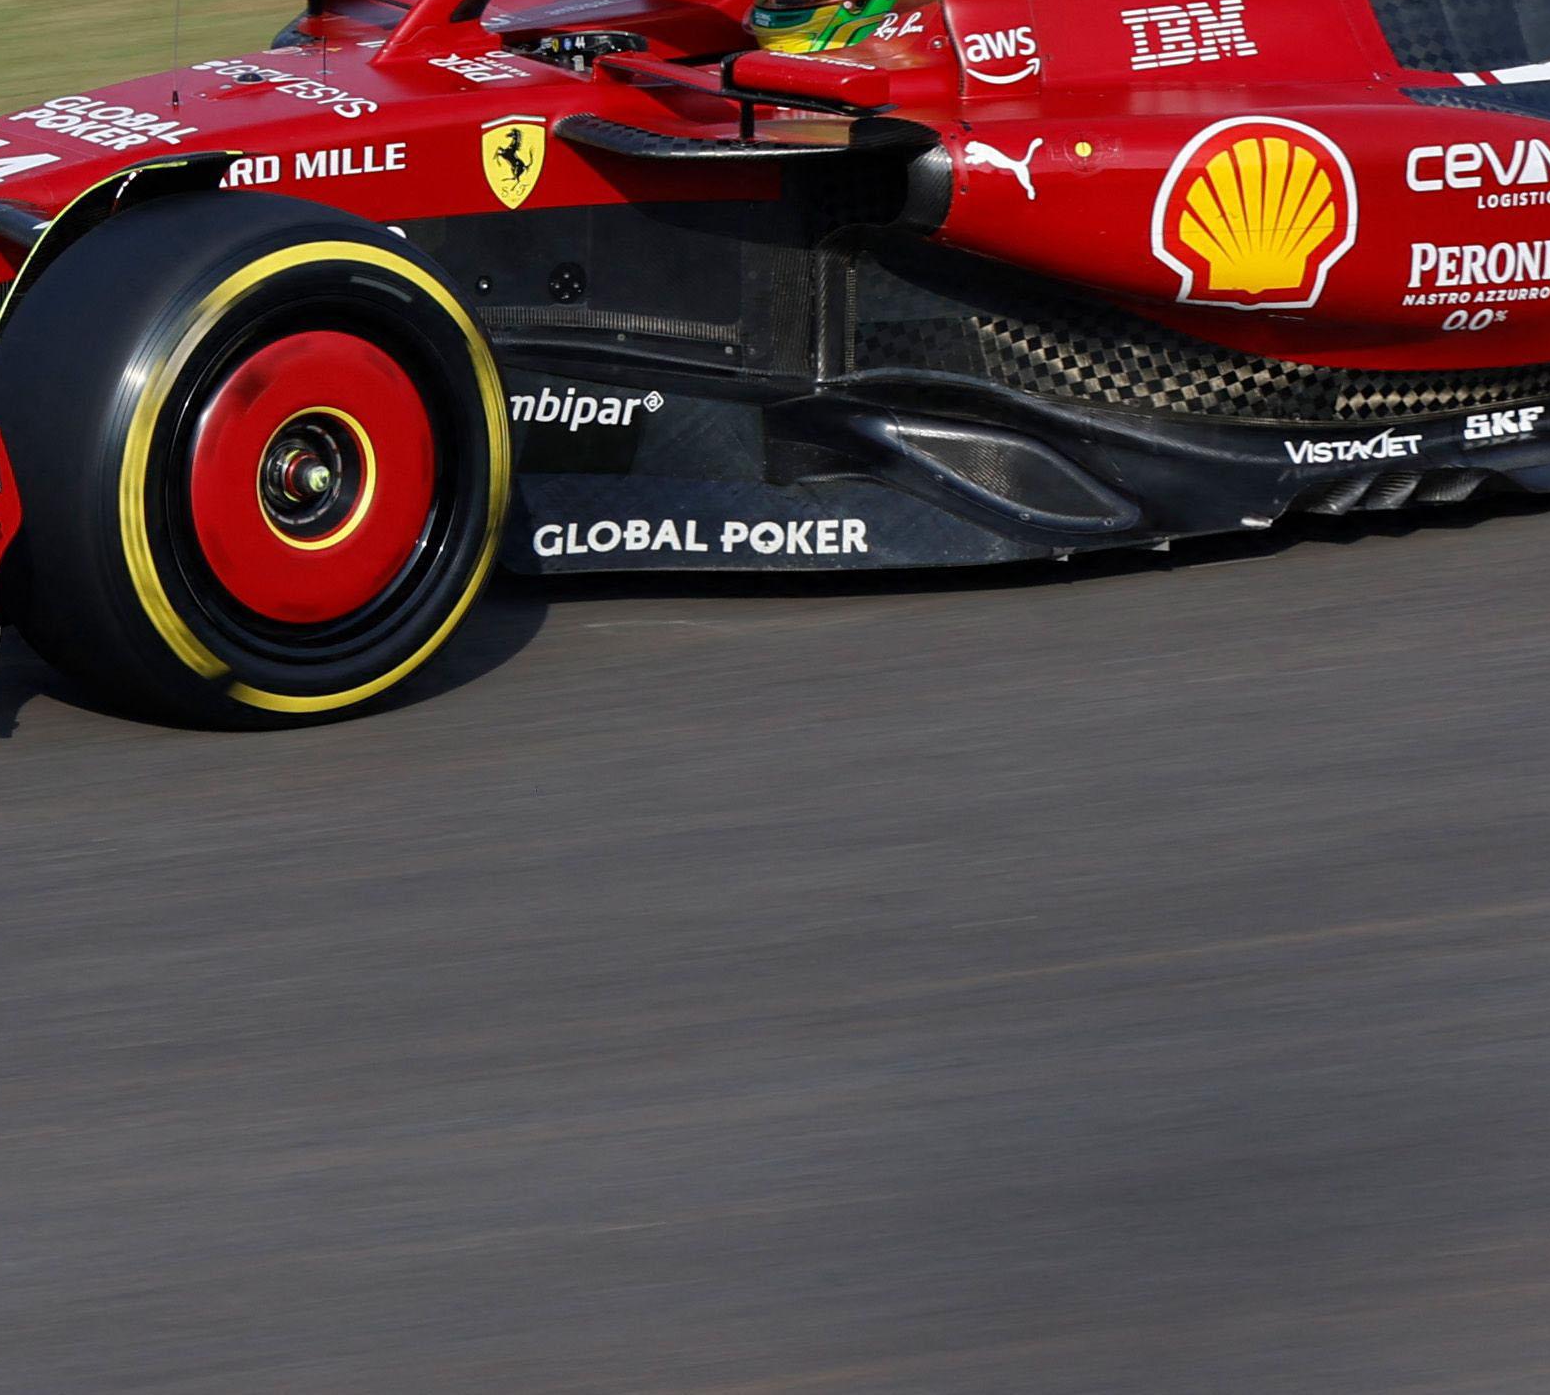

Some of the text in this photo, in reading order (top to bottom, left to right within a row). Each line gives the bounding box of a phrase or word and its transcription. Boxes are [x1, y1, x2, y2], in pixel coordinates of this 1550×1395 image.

[965, 26, 1037, 64] aws
[8, 108, 151, 151] POKER
[43, 95, 199, 145] GLOBAL
[219, 143, 407, 188] RD MILLE
[1402, 291, 1471, 307] NASTRO
[1464, 405, 1545, 441] SKF
[533, 518, 868, 557] GLOBAL POKER
